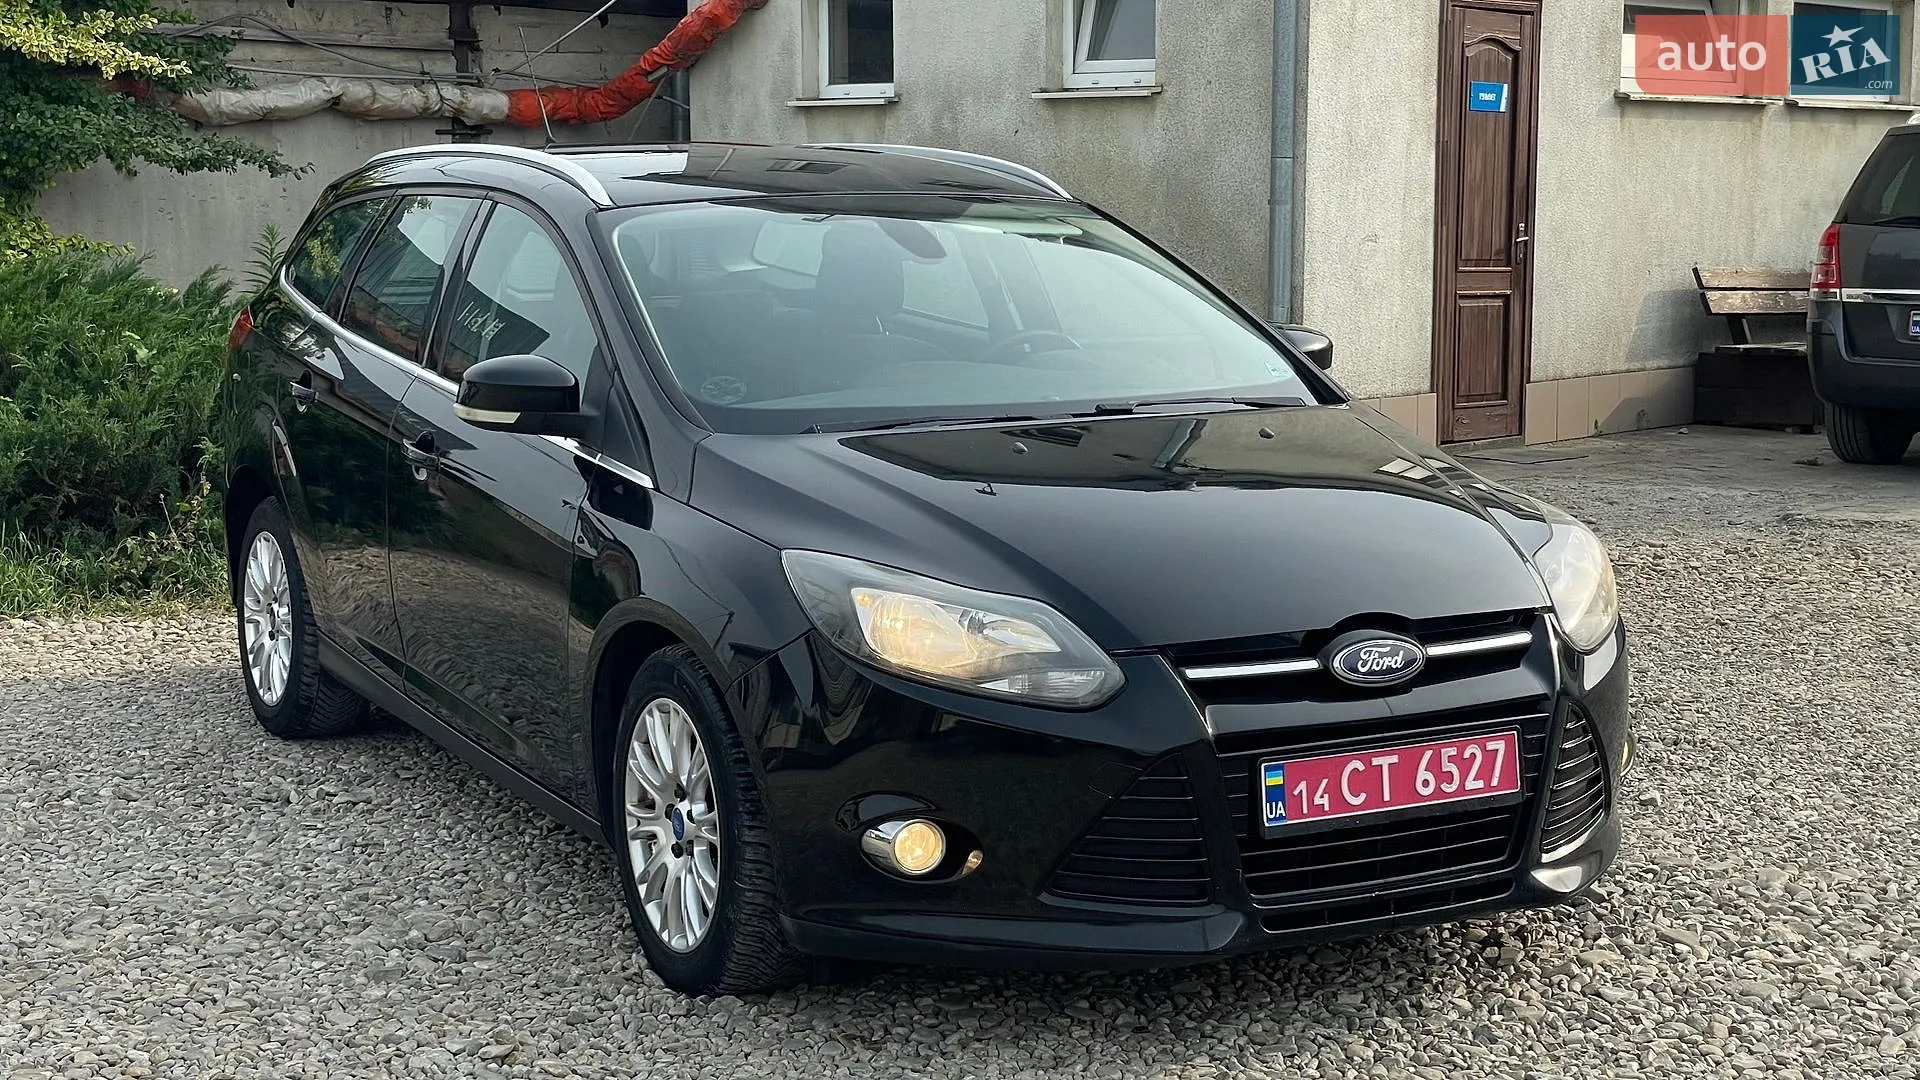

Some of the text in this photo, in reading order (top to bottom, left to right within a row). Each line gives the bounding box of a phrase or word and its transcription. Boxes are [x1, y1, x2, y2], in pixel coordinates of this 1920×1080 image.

[1357, 646, 1405, 673] Ford
[1293, 740, 1505, 815] 14 CT 6527
[1266, 800, 1286, 819] UA
